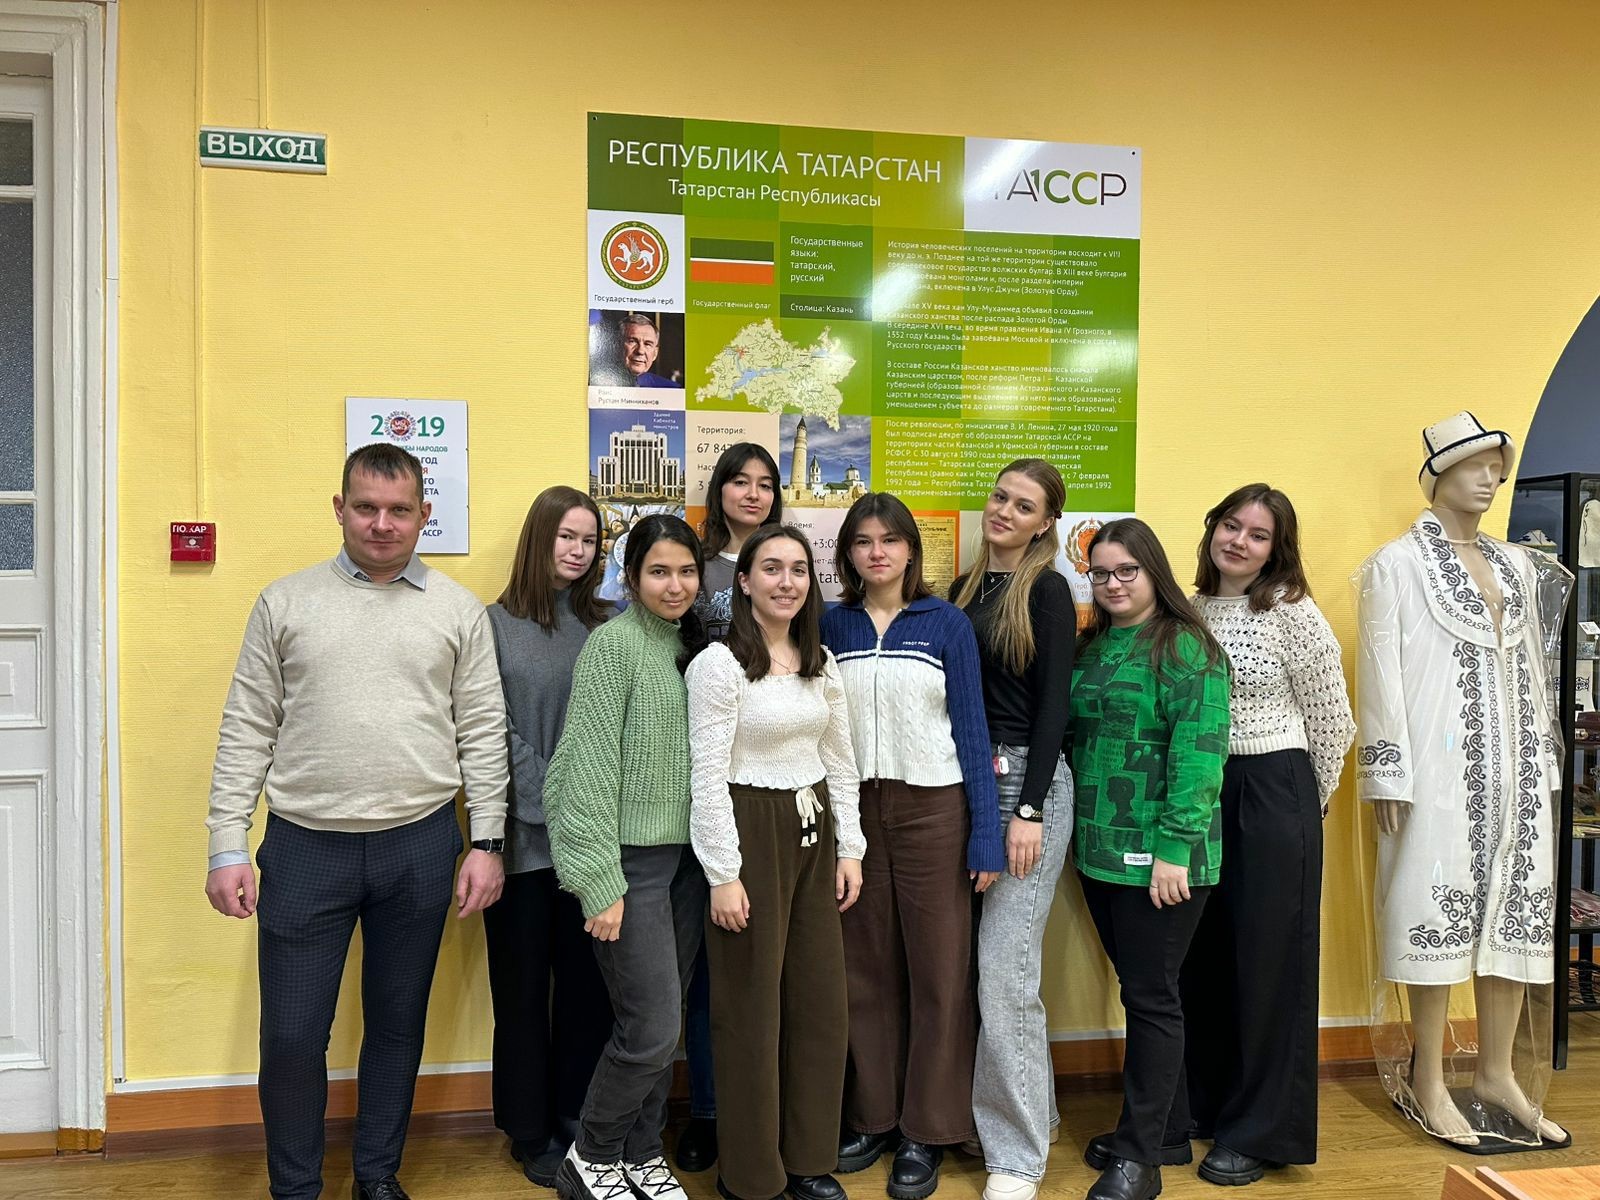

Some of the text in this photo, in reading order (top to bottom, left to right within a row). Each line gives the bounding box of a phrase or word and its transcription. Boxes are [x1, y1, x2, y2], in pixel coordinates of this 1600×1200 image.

[207, 133, 318, 162] ВЫХОД
[608, 140, 942, 184] РЕСПУБЛИКА ТАТАРСТАН
[668, 179, 882, 209] Татарстан Республикасы
[790, 235, 864, 249] Государственные
[790, 249, 819, 259] языки:
[888, 240, 919, 250] История
[921, 243, 971, 251] человеческих
[972, 244, 1011, 253] поселений
[1024, 248, 1066, 257] территории
[1068, 250, 1102, 258] восходит
[932, 252, 1097, 268] Позднее территории существовало
[790, 261, 836, 273] татарский,
[945, 265, 990, 273] государство
[1094, 269, 1127, 279] Булгария
[790, 273, 825, 284] русский
[1020, 278, 1050, 286] раздела
[1051, 279, 1084, 287] империи
[978, 284, 994, 293] Улус
[995, 285, 1020, 294] Джучи
[1021, 286, 1055, 296] (Золотую
[1057, 287, 1080, 297] Орду).
[594, 294, 674, 306] Государственный герб
[692, 299, 771, 310] Государственный флаг
[790, 303, 854, 314] Столица: Казань
[966, 304, 1020, 314] Улу-Мухаммед
[1021, 305, 1051, 313] объявил
[984, 316, 1014, 324] распада
[1016, 315, 1046, 323] Золотой
[975, 325, 997, 333] время
[999, 326, 1037, 334] правления
[1072, 327, 1106, 336] Грозного,
[924, 332, 949, 340] Казань
[1010, 335, 1042, 343] Москвой
[887, 340, 919, 350] Русского
[950, 362, 988, 370] Казанское
[927, 373, 964, 381] царством,
[988, 373, 1017, 383] реформ
[1018, 374, 1040, 383] Петра
[1055, 375, 1093, 383] Казанской
[886, 380, 924, 390] губернией
[926, 381, 980, 391] (образованной
[1019, 384, 1072, 394] Астраханского
[1080, 385, 1121, 393] Казанского
[919, 393, 970, 401] последующим
[1068, 394, 1117, 404] образований,
[886, 401, 1117, 414] уменьшением субъекта современного Татарстана).
[697, 425, 747, 436] Территория:
[1026, 423, 1056, 431] Ленина,
[975, 431, 1023, 441] образовании
[1025, 432, 1061, 442] Татарской
[697, 443, 711, 454] 67
[886, 441, 932, 449] территориях
[1001, 442, 1037, 451] Уфимской
[1039, 442, 1073, 451] губернии
[421, 456, 438, 465] ГОД
[996, 451, 1045, 461] официальное
[885, 458, 928, 468] республики
[939, 460, 975, 469] Татарская
[886, 468, 1110, 481] Республика (равно февраля
[932, 479, 973, 488] Республика
[1067, 482, 1093, 490] апреля
[1095, 481, 1112, 489] 1992
[172, 524, 207, 533] ПОАР
